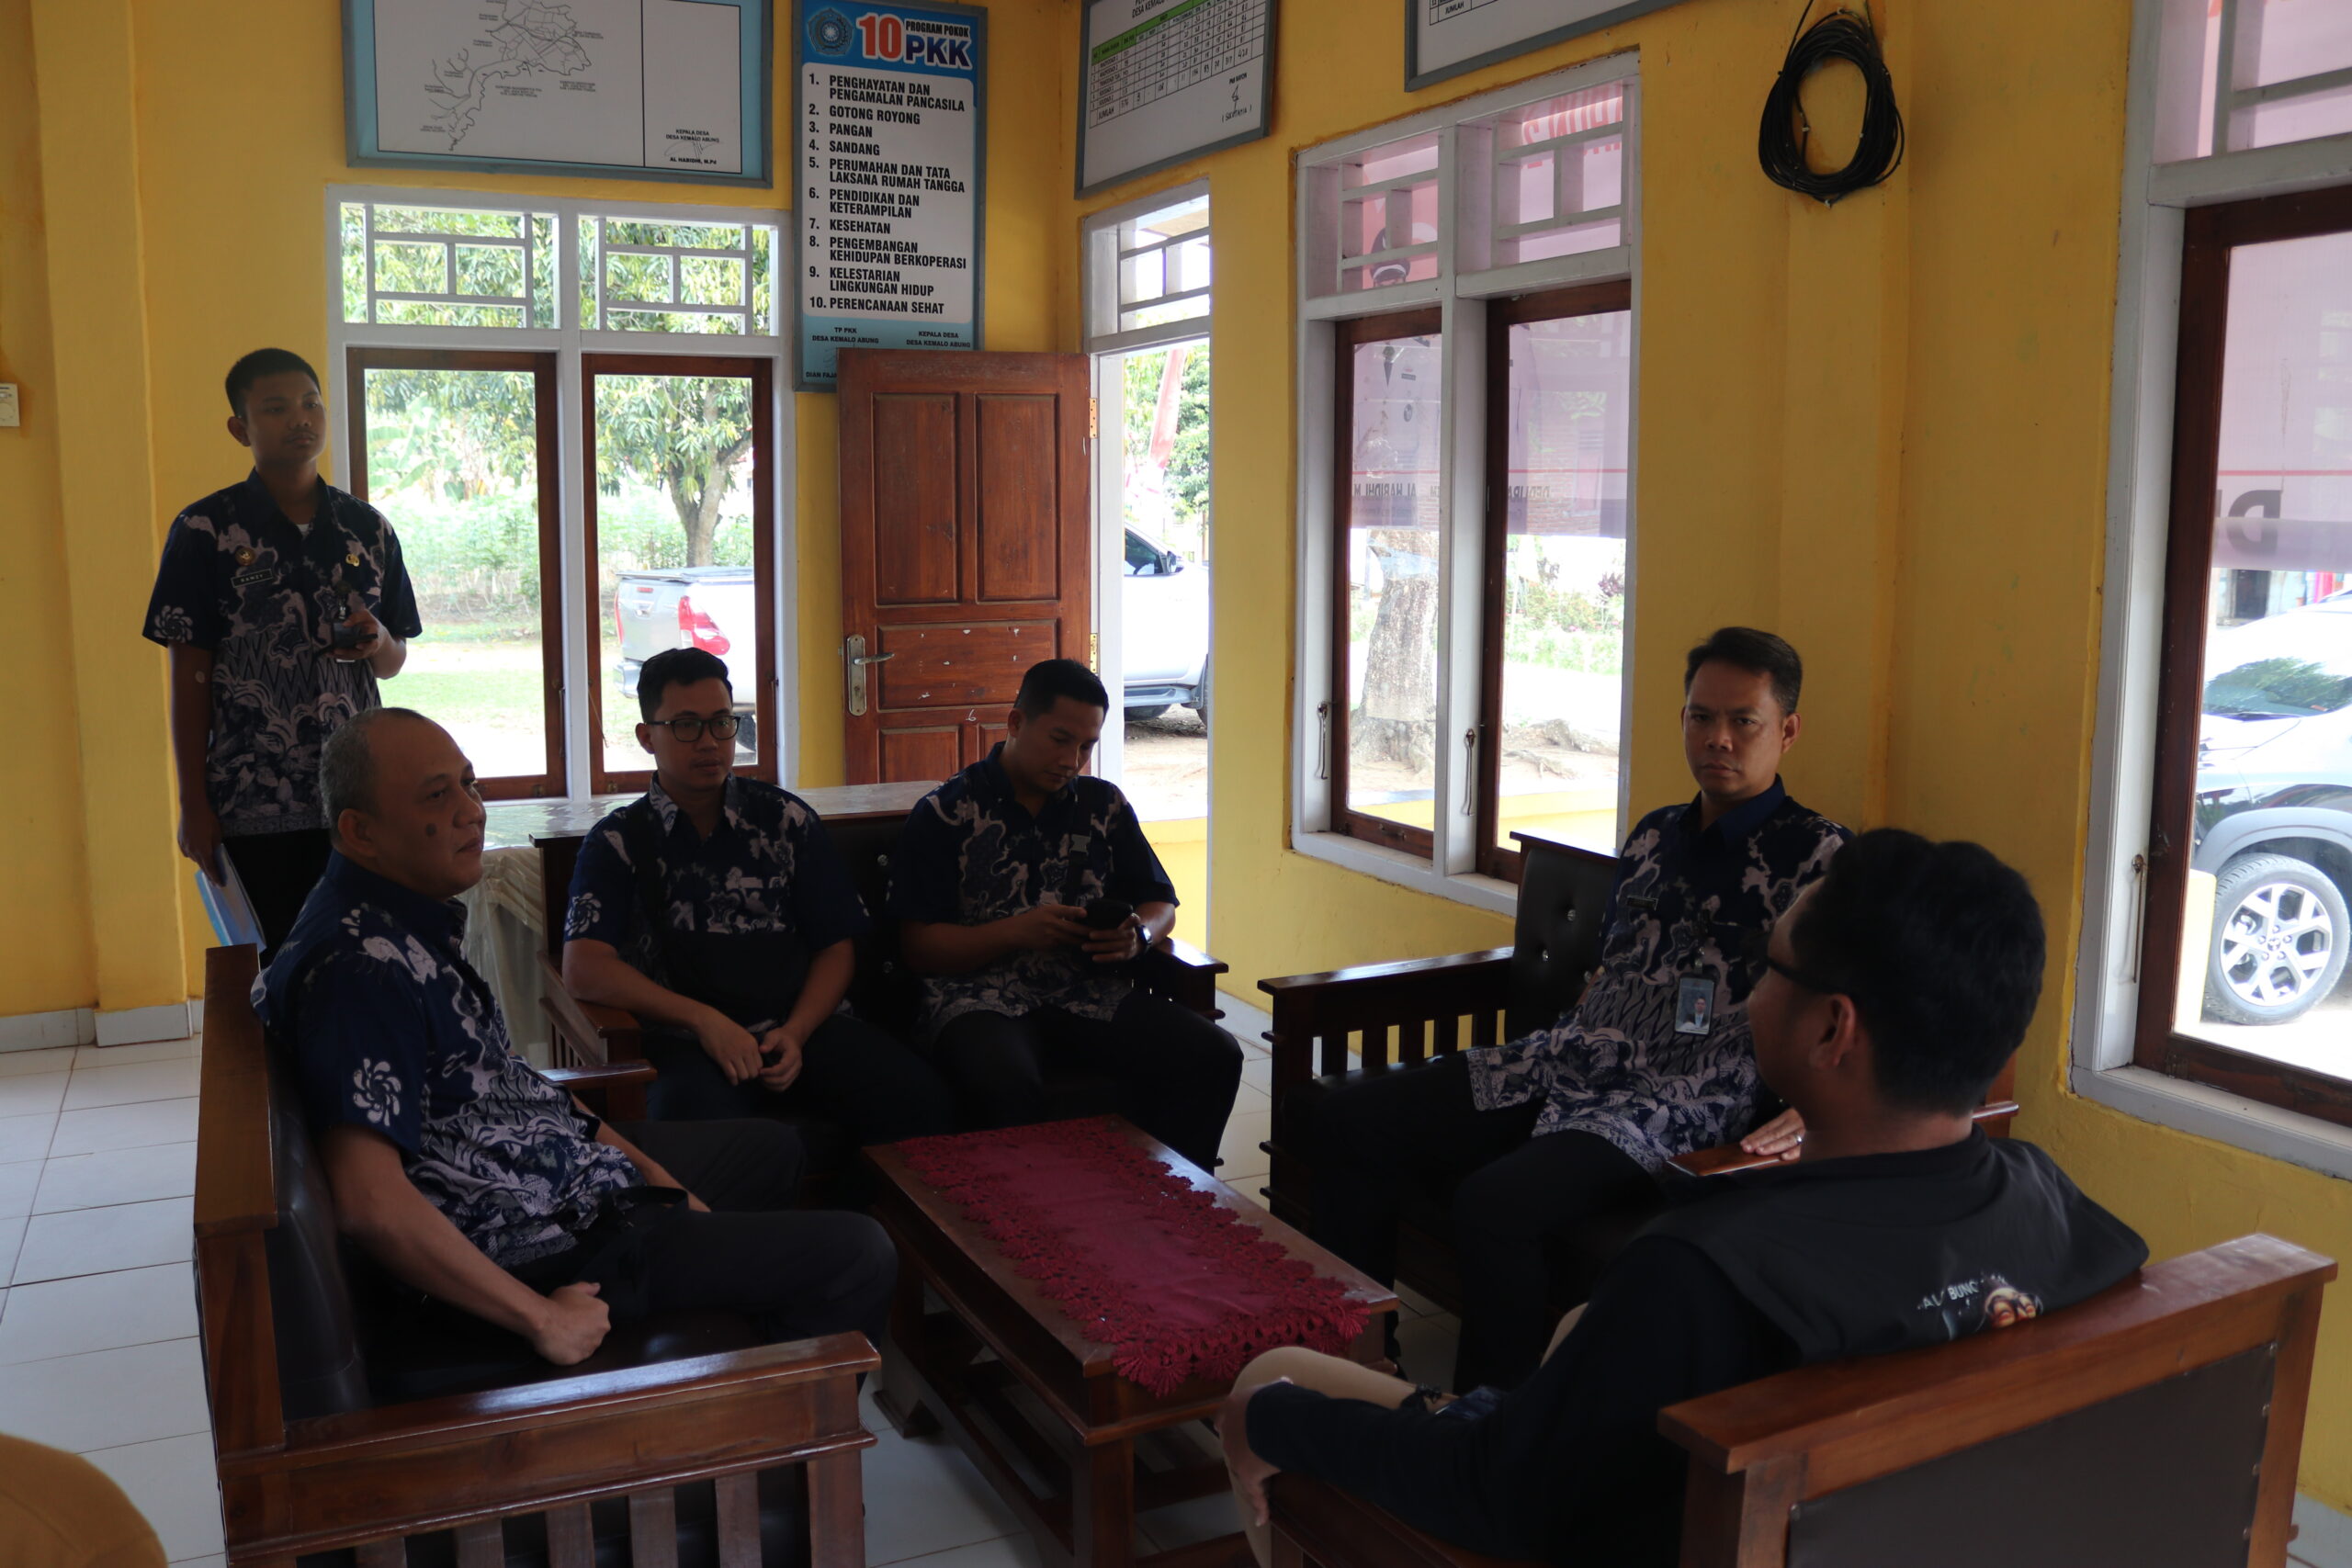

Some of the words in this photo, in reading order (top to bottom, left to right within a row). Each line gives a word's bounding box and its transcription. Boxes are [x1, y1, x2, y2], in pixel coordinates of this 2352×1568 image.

[1445, 1, 1464, 15] JUMLAH
[858, 16, 901, 59] 10
[906, 20, 943, 34] PROGRAM
[944, 23, 969, 38] POKOK
[906, 35, 970, 67] PKK
[808, 73, 820, 85] 1.
[830, 74, 906, 94] PENGHAYATAN
[909, 83, 930, 96] DAN
[830, 88, 903, 107] PENGAMALAN
[907, 96, 965, 112] PANCASILA
[808, 104, 820, 116] 2.
[829, 105, 874, 120] GOTONG
[876, 109, 921, 125] ROYONG
[808, 121, 820, 133] 3.
[830, 123, 873, 138] PANGAN
[808, 139, 820, 151] 4.
[829, 141, 880, 156] SANDANG
[808, 156, 820, 169] 5.
[830, 158, 898, 175] PERUMAHAN
[900, 164, 922, 176] DAN
[926, 166, 951, 179] TATA
[830, 171, 878, 186] LAKSANA
[881, 175, 921, 189] RUMAH
[923, 177, 965, 193] TANGGA
[808, 187, 820, 199] 6.
[830, 188, 895, 204] PENDIDIKAN
[898, 194, 920, 207] DAN
[830, 202, 912, 219] KETERAMPILAN
[809, 218, 820, 230] 7.
[830, 219, 891, 234] KESEHATAN
[809, 235, 820, 247] 8.
[830, 236, 919, 254] PENGEMBANGAN
[830, 250, 890, 265] KEHIDUPAN
[894, 254, 967, 269] BERKOPERASI
[809, 266, 820, 277] 9.
[830, 266, 900, 282] KELESTARIAN
[830, 280, 898, 295] LINGKUNGAN
[900, 284, 934, 297] HIDUP
[809, 297, 827, 309] 10.
[830, 297, 908, 312] PERENCANAAN
[911, 301, 944, 314] SEHAT
[918, 330, 941, 338] KEPALA
